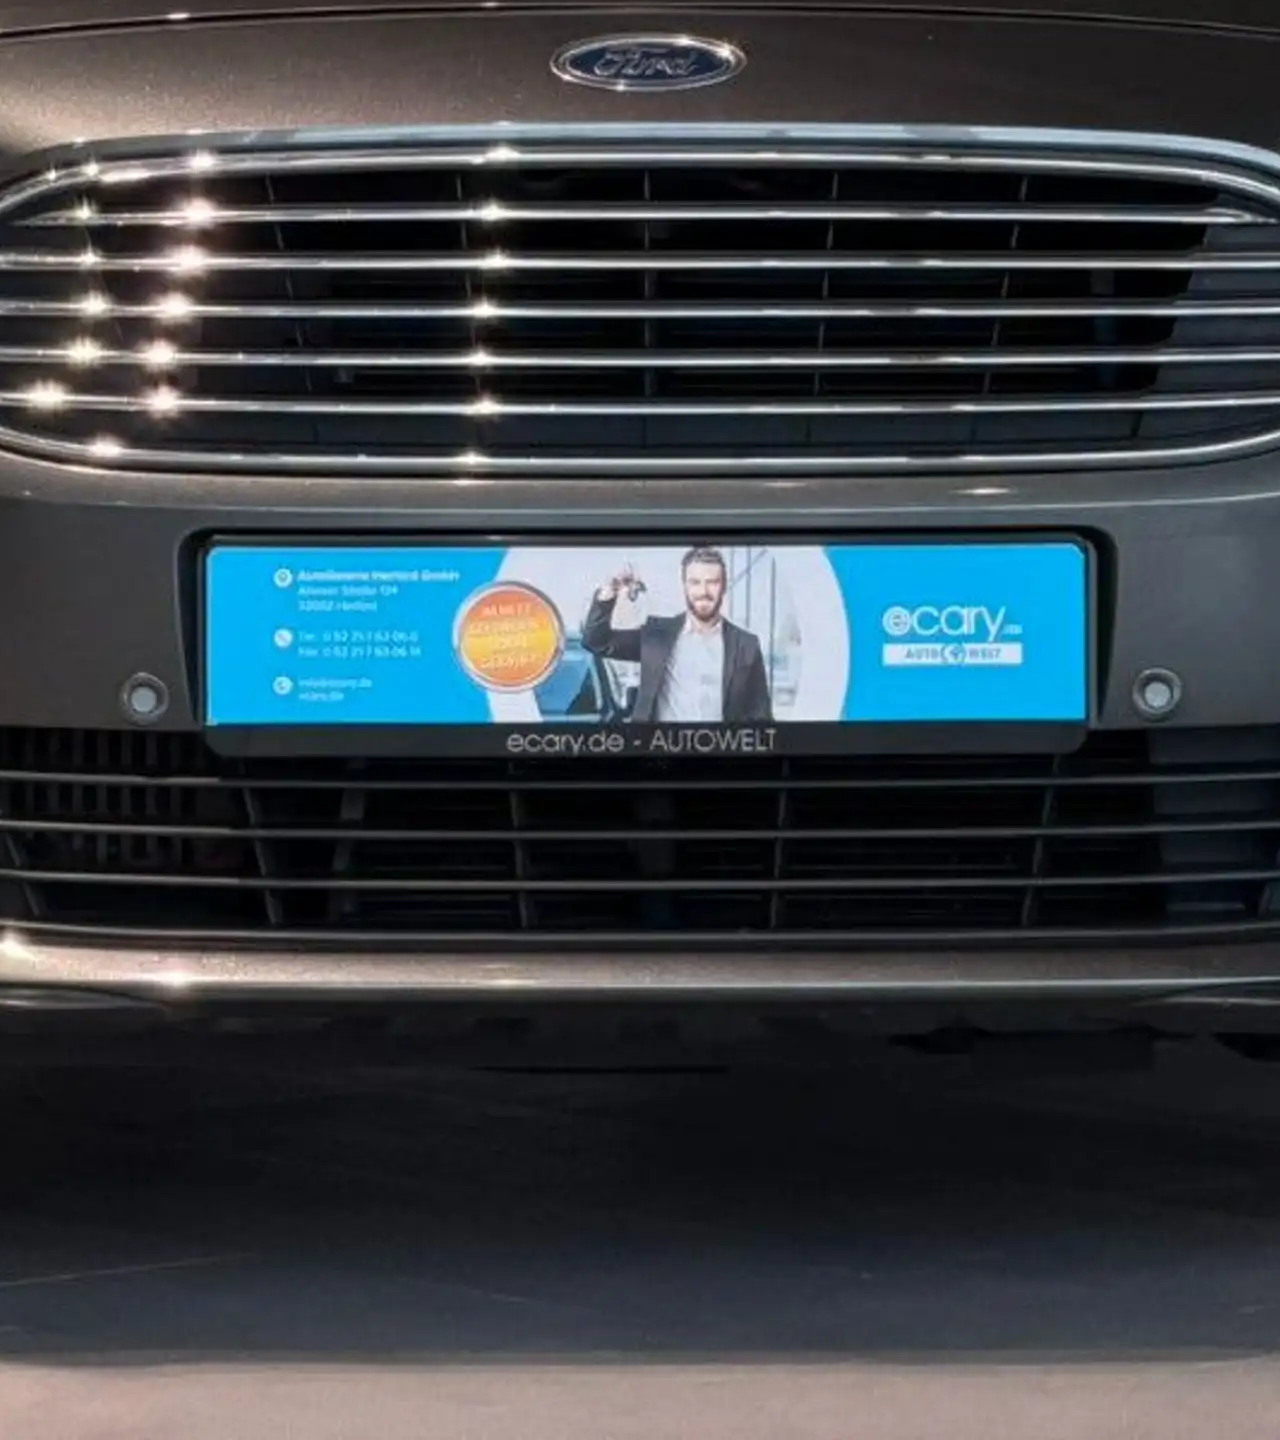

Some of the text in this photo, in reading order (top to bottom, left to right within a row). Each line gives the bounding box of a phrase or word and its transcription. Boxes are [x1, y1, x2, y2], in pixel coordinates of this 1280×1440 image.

[593, 47, 702, 76] Ford
[506, 732, 625, 757] ecary.de
[649, 728, 778, 752] AUTOWELT
